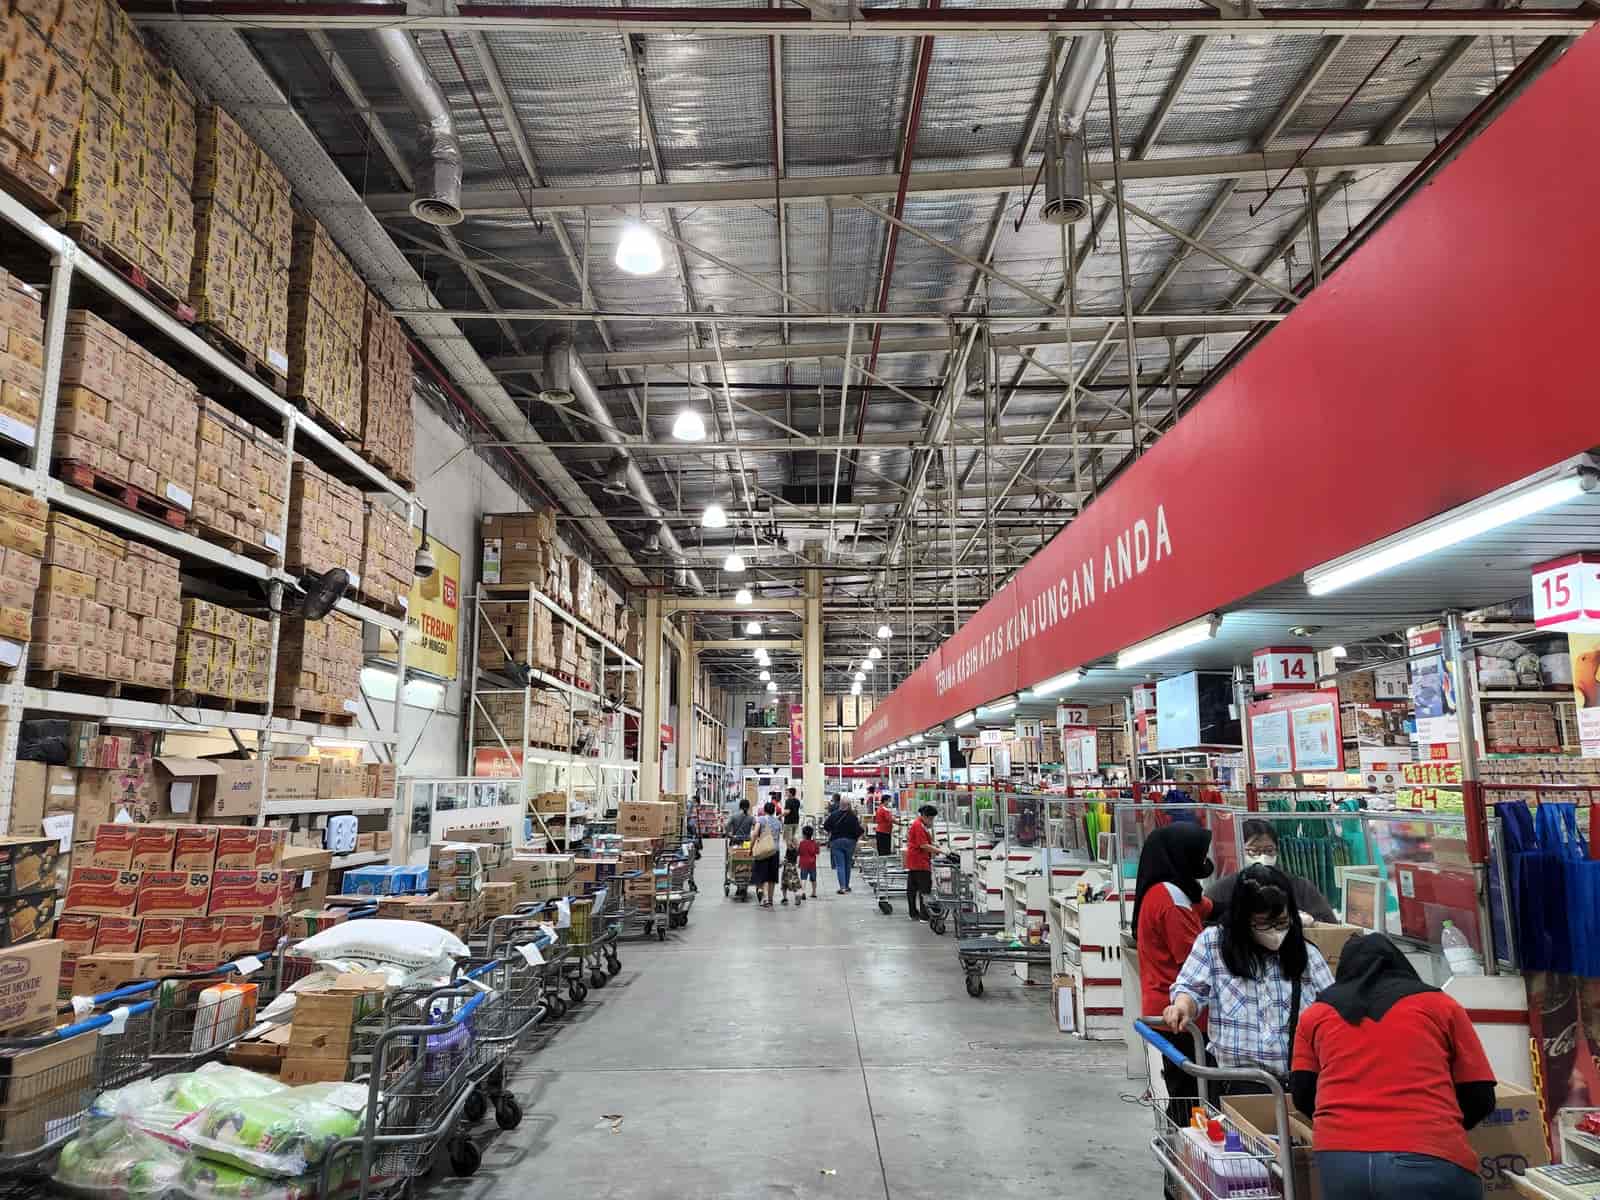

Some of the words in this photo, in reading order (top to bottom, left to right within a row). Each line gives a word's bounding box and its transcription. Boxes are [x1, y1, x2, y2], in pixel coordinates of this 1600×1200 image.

[957, 643, 978, 684] KASIH
[979, 624, 1004, 669] ATAS
[1006, 557, 1096, 653] KUNJUNGAN
[1103, 503, 1173, 594] ANDA
[1541, 572, 1571, 610] 15
[421, 613, 455, 643] TERBAIK
[1280, 657, 1307, 680] 14
[1068, 710, 1084, 724] 12
[1024, 725, 1035, 738] 11
[1403, 762, 1458, 784] LOTTE
[1411, 787, 1438, 809] 04
[119, 871, 139, 885] 50
[190, 873, 209, 886] 50
[260, 871, 279, 884] 50
